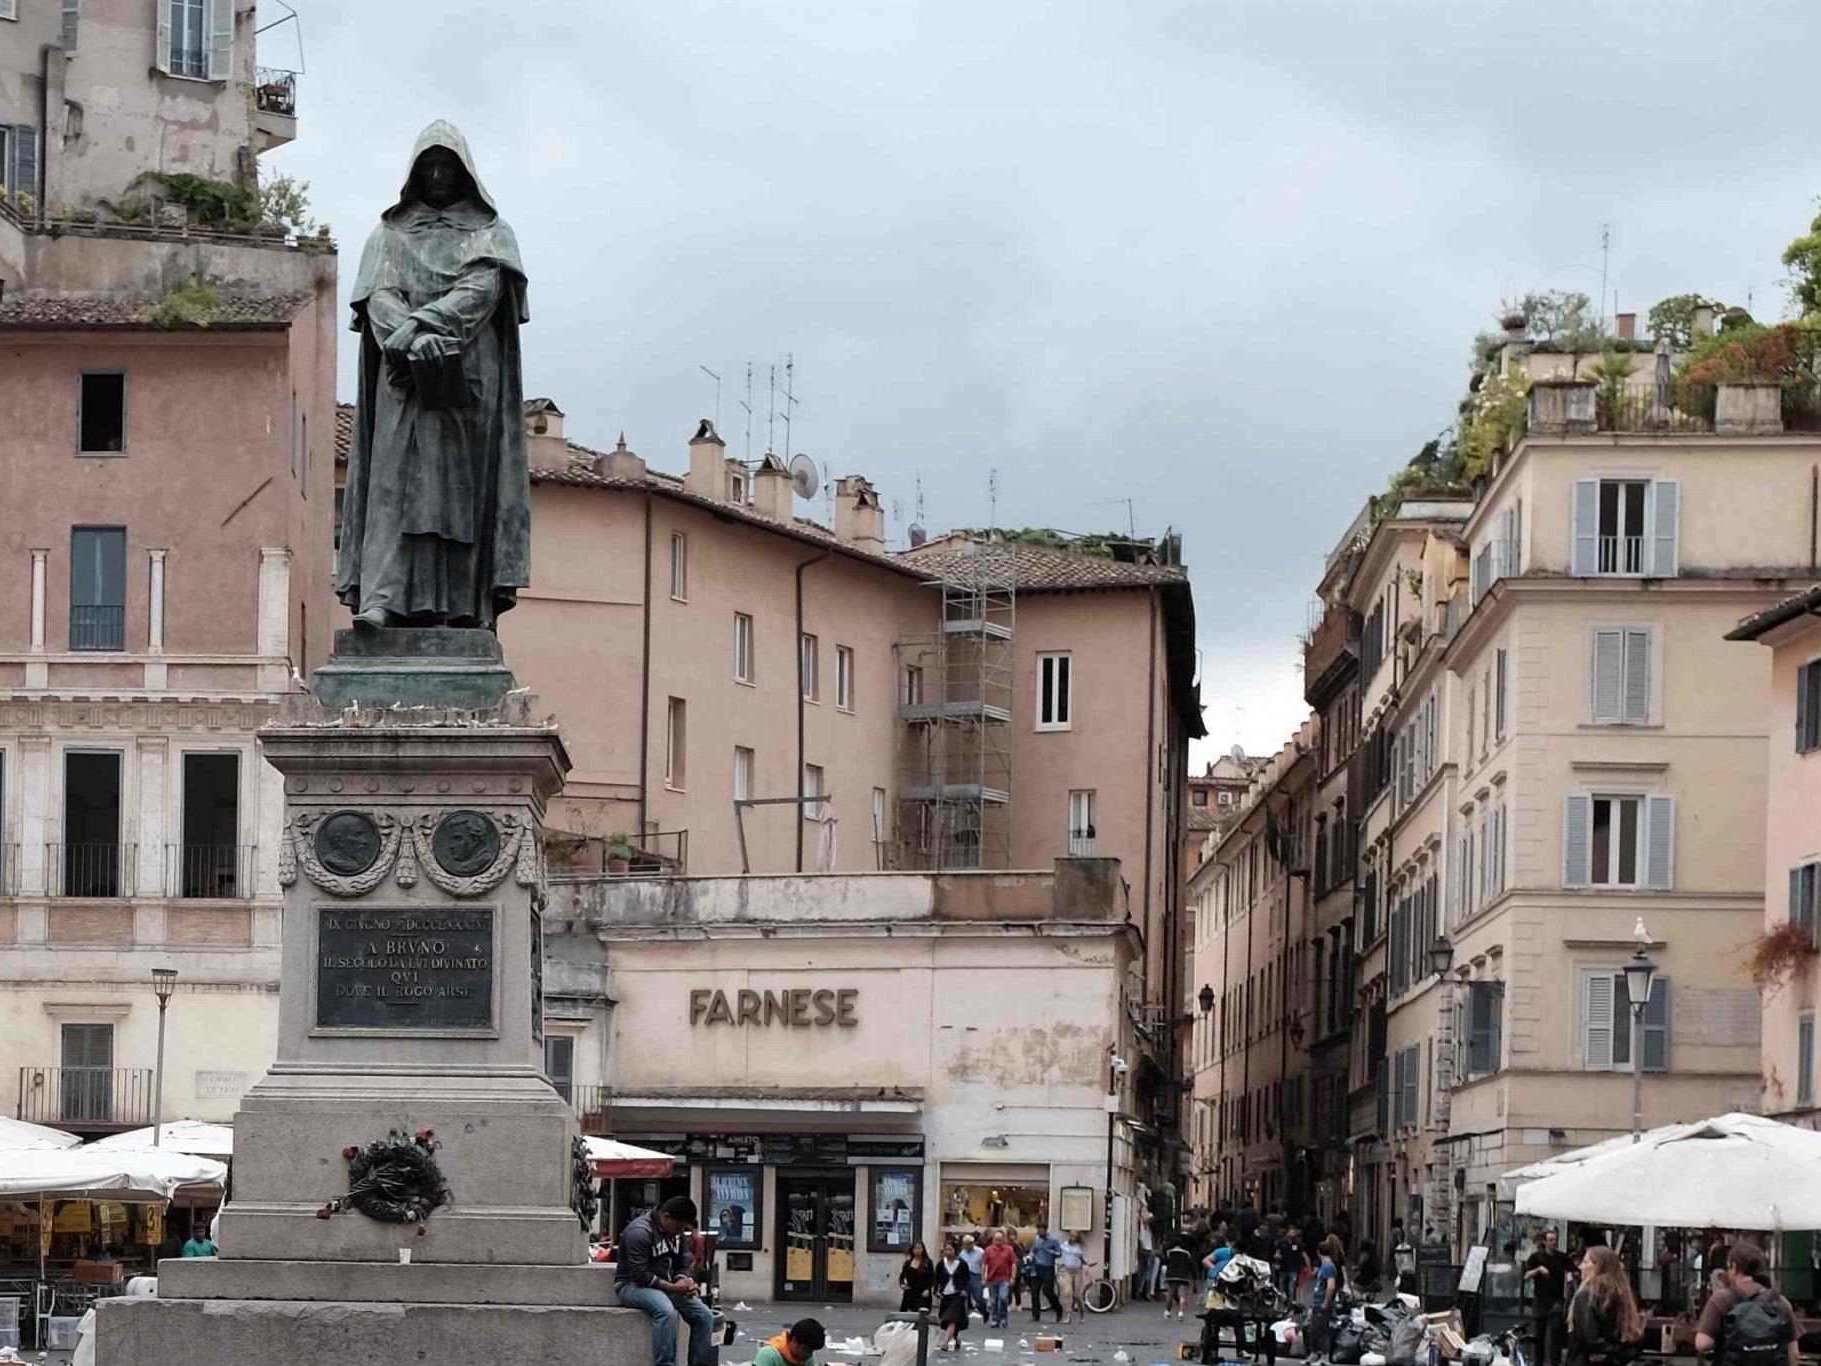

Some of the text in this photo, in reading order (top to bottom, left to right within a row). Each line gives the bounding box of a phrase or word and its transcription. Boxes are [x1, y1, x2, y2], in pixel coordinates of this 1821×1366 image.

[367, 941, 446, 955] A BRVNO
[338, 957, 387, 968] SECOLO
[431, 957, 487, 969] DIVINATO
[391, 971, 419, 985] QVI
[377, 986, 388, 996] IL
[396, 986, 433, 997] ROGO
[690, 988, 860, 1027] FARNESE
